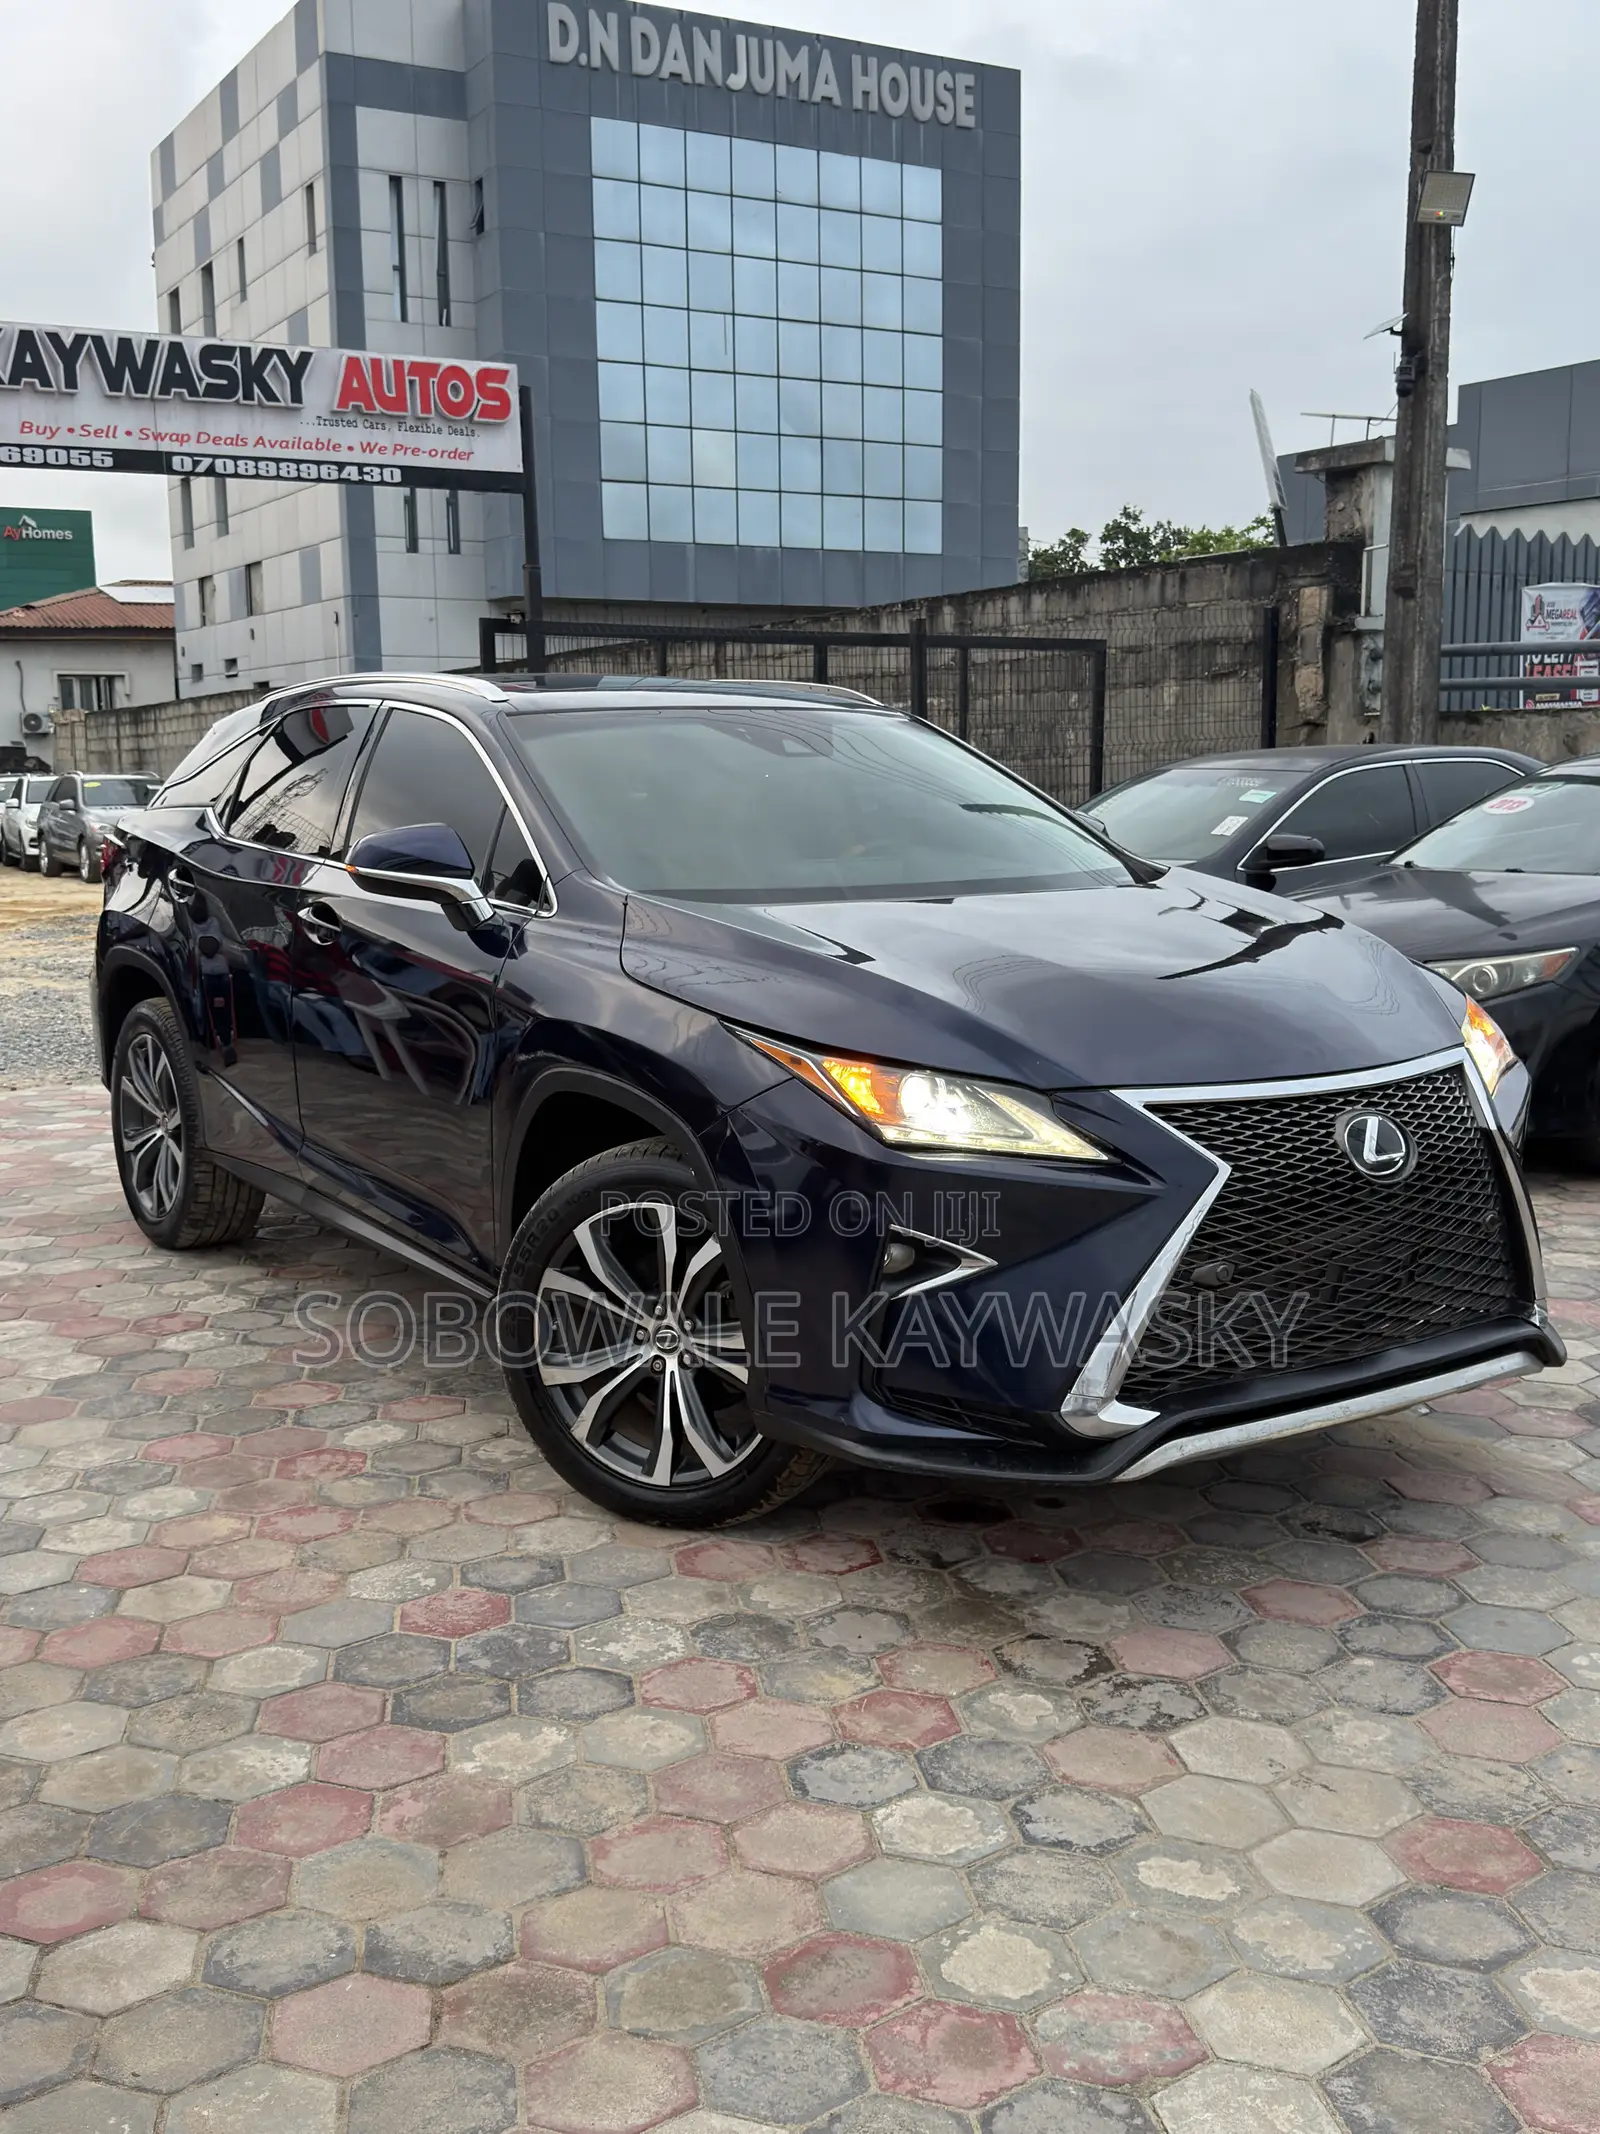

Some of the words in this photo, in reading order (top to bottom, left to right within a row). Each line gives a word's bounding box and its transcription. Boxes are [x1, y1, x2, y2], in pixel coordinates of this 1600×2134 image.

[547, 2, 619, 72] D.N
[851, 54, 976, 128] HOUSE
[0, 327, 315, 407] AYWASKY
[333, 355, 512, 422] AUTOS
[20, 421, 61, 439] Buy
[79, 424, 118, 439] Sell
[138, 428, 191, 446] Swap
[196, 431, 248, 447] Deals
[253, 434, 342, 452] Available
[359, 441, 388, 455] We
[393, 444, 475, 461] Pre-order
[363, 419, 391, 432] Cars,
[397, 422, 443, 435] Flexible
[448, 426, 481, 438] Deals.
[0, 446, 114, 468] 69055
[171, 456, 402, 483] 07089896430
[4, 526, 73, 540] AyHomes
